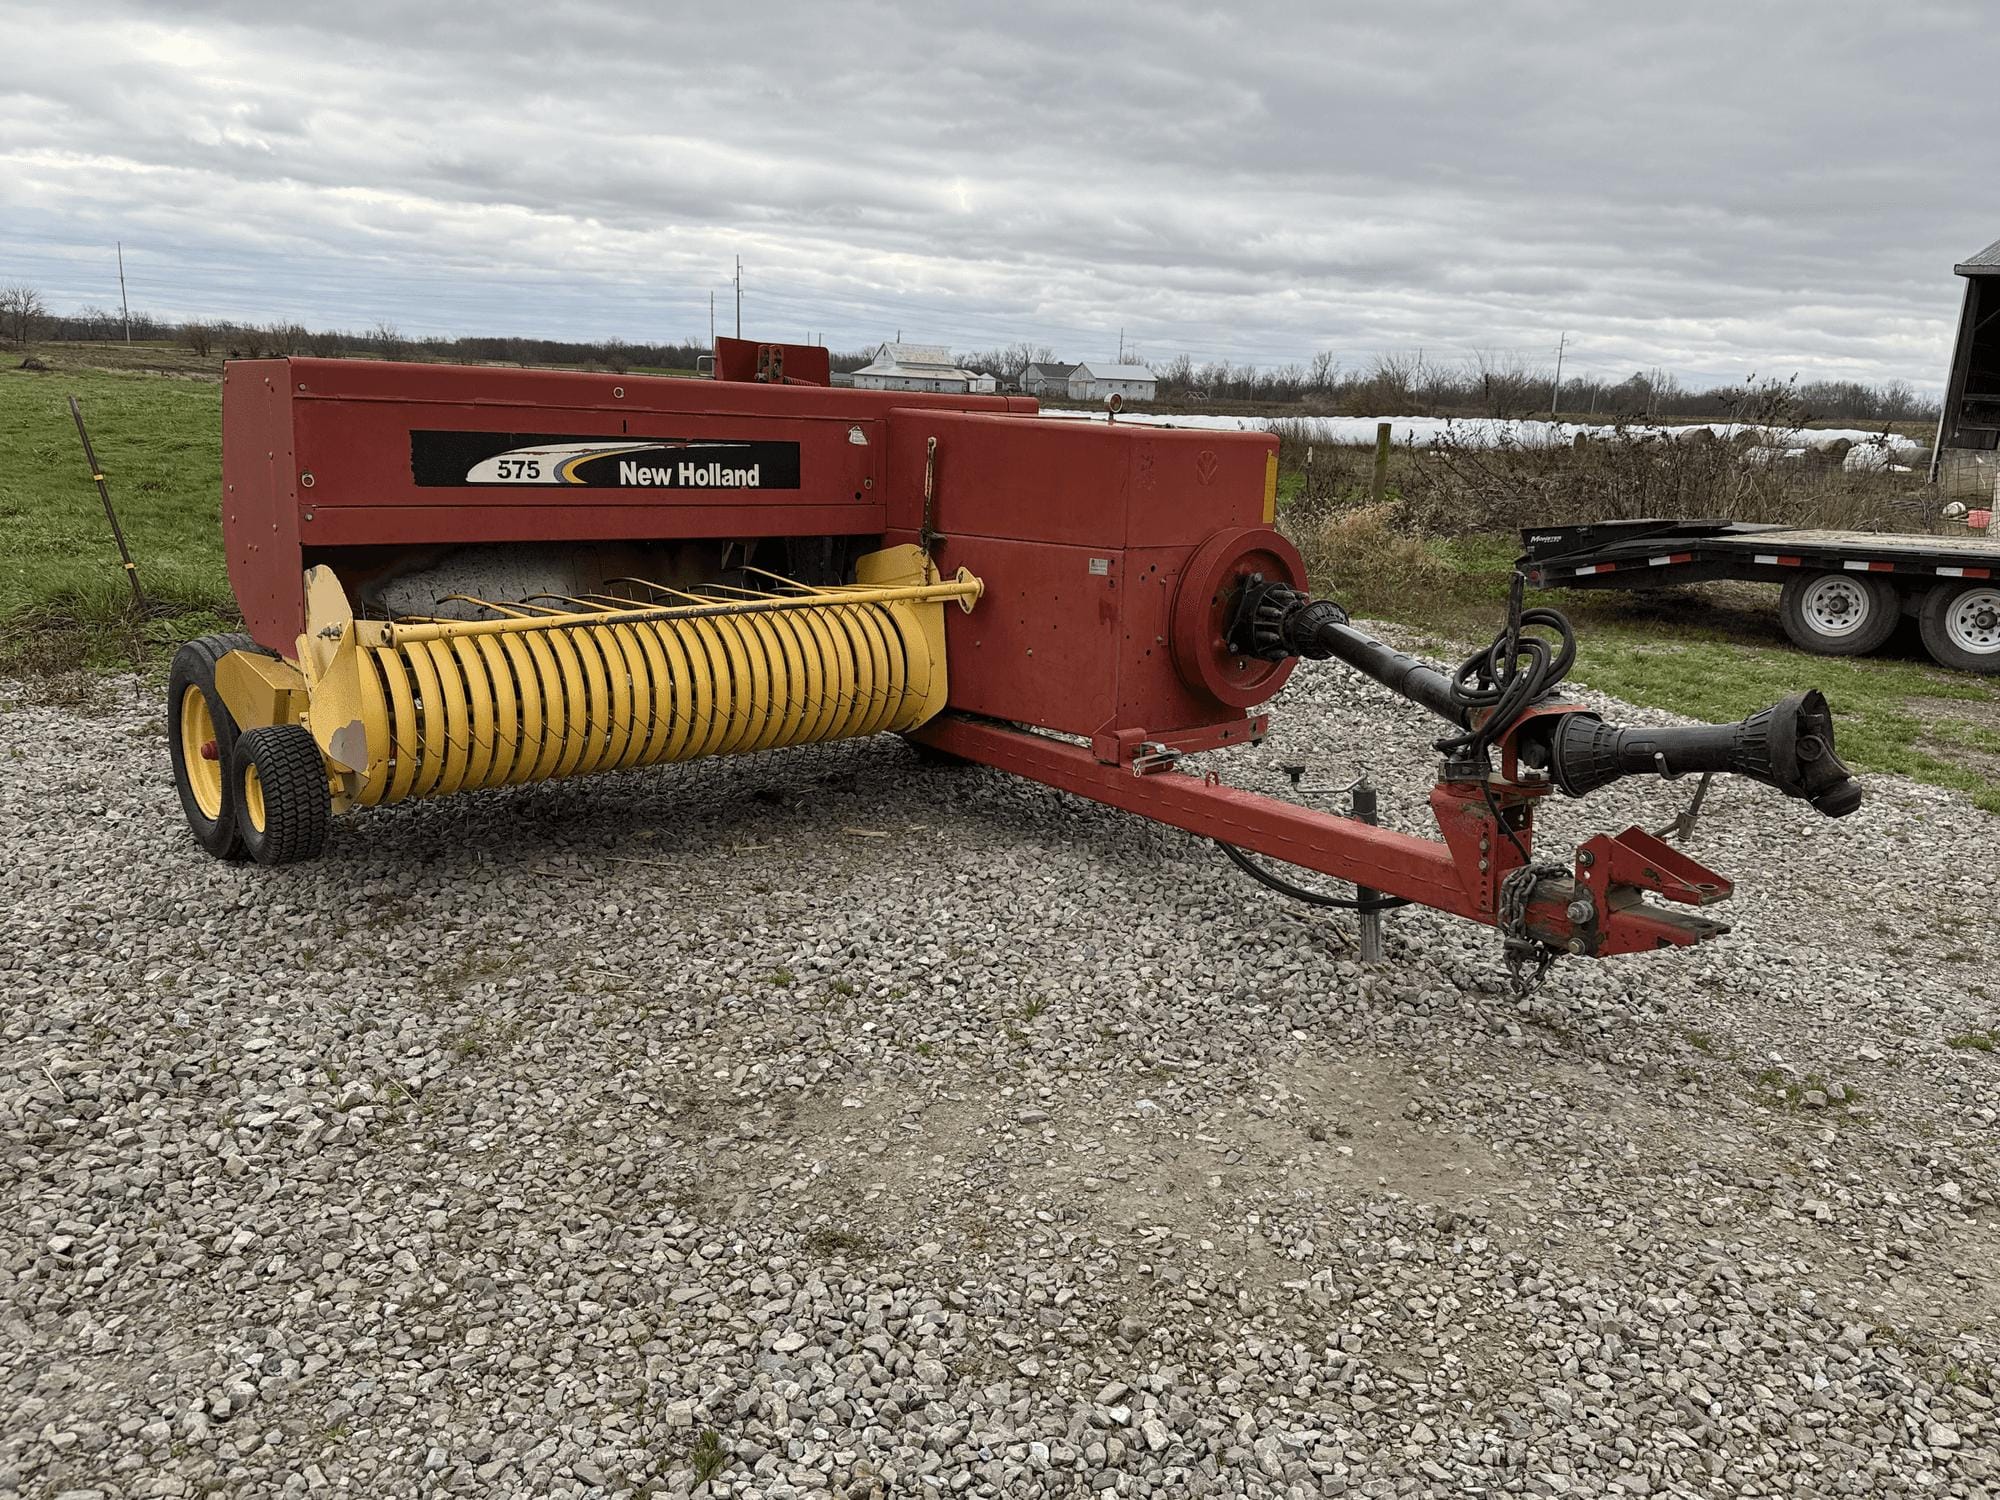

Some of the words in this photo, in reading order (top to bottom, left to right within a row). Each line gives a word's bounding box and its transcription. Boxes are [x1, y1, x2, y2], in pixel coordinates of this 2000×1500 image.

[497, 460, 541, 479] 575
[619, 460, 673, 486] New
[678, 462, 760, 487] Holland
